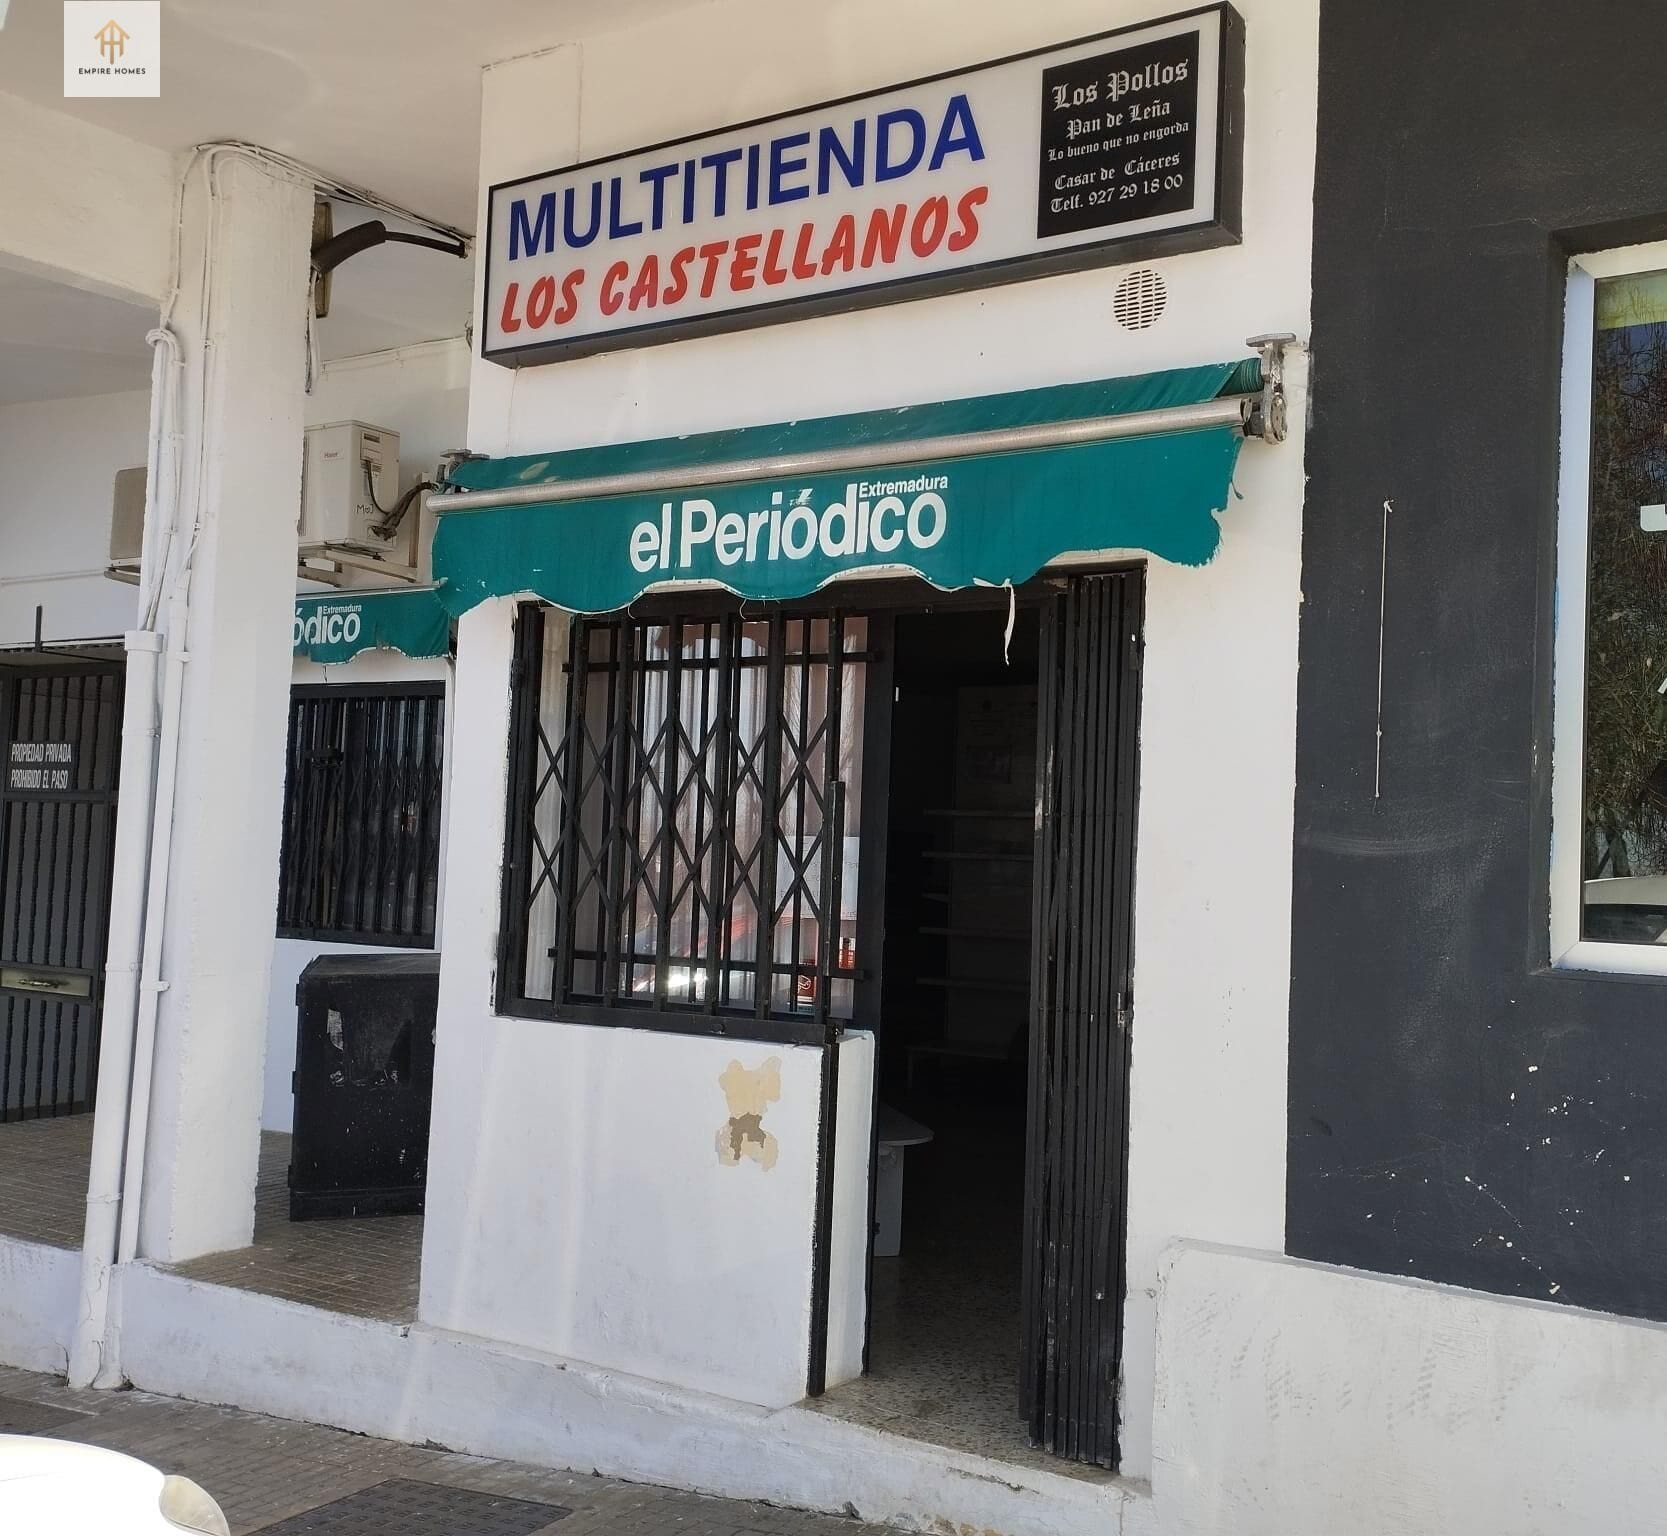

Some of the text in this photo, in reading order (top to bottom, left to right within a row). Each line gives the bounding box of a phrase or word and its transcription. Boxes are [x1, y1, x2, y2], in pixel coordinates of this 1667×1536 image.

[1052, 58, 1189, 111] Los Pollos
[1066, 99, 1171, 140] Pan de Leña
[1048, 121, 1189, 161] Lo bueno que no engorda
[508, 94, 985, 261] MULTITIENDA
[1054, 152, 1180, 190] Casar de Cáceres
[1050, 174, 1183, 213] Telf. 927 29 18 00
[500, 186, 989, 333] LOS CASTELLANOS
[859, 475, 948, 499] Extremadura
[629, 484, 947, 573] el Periódico
[323, 603, 362, 615] Extremadura
[11, 743, 72, 762] PROPIEDAD PRIVADA
[10, 769, 69, 790] PROHIBIDO EL PASO
